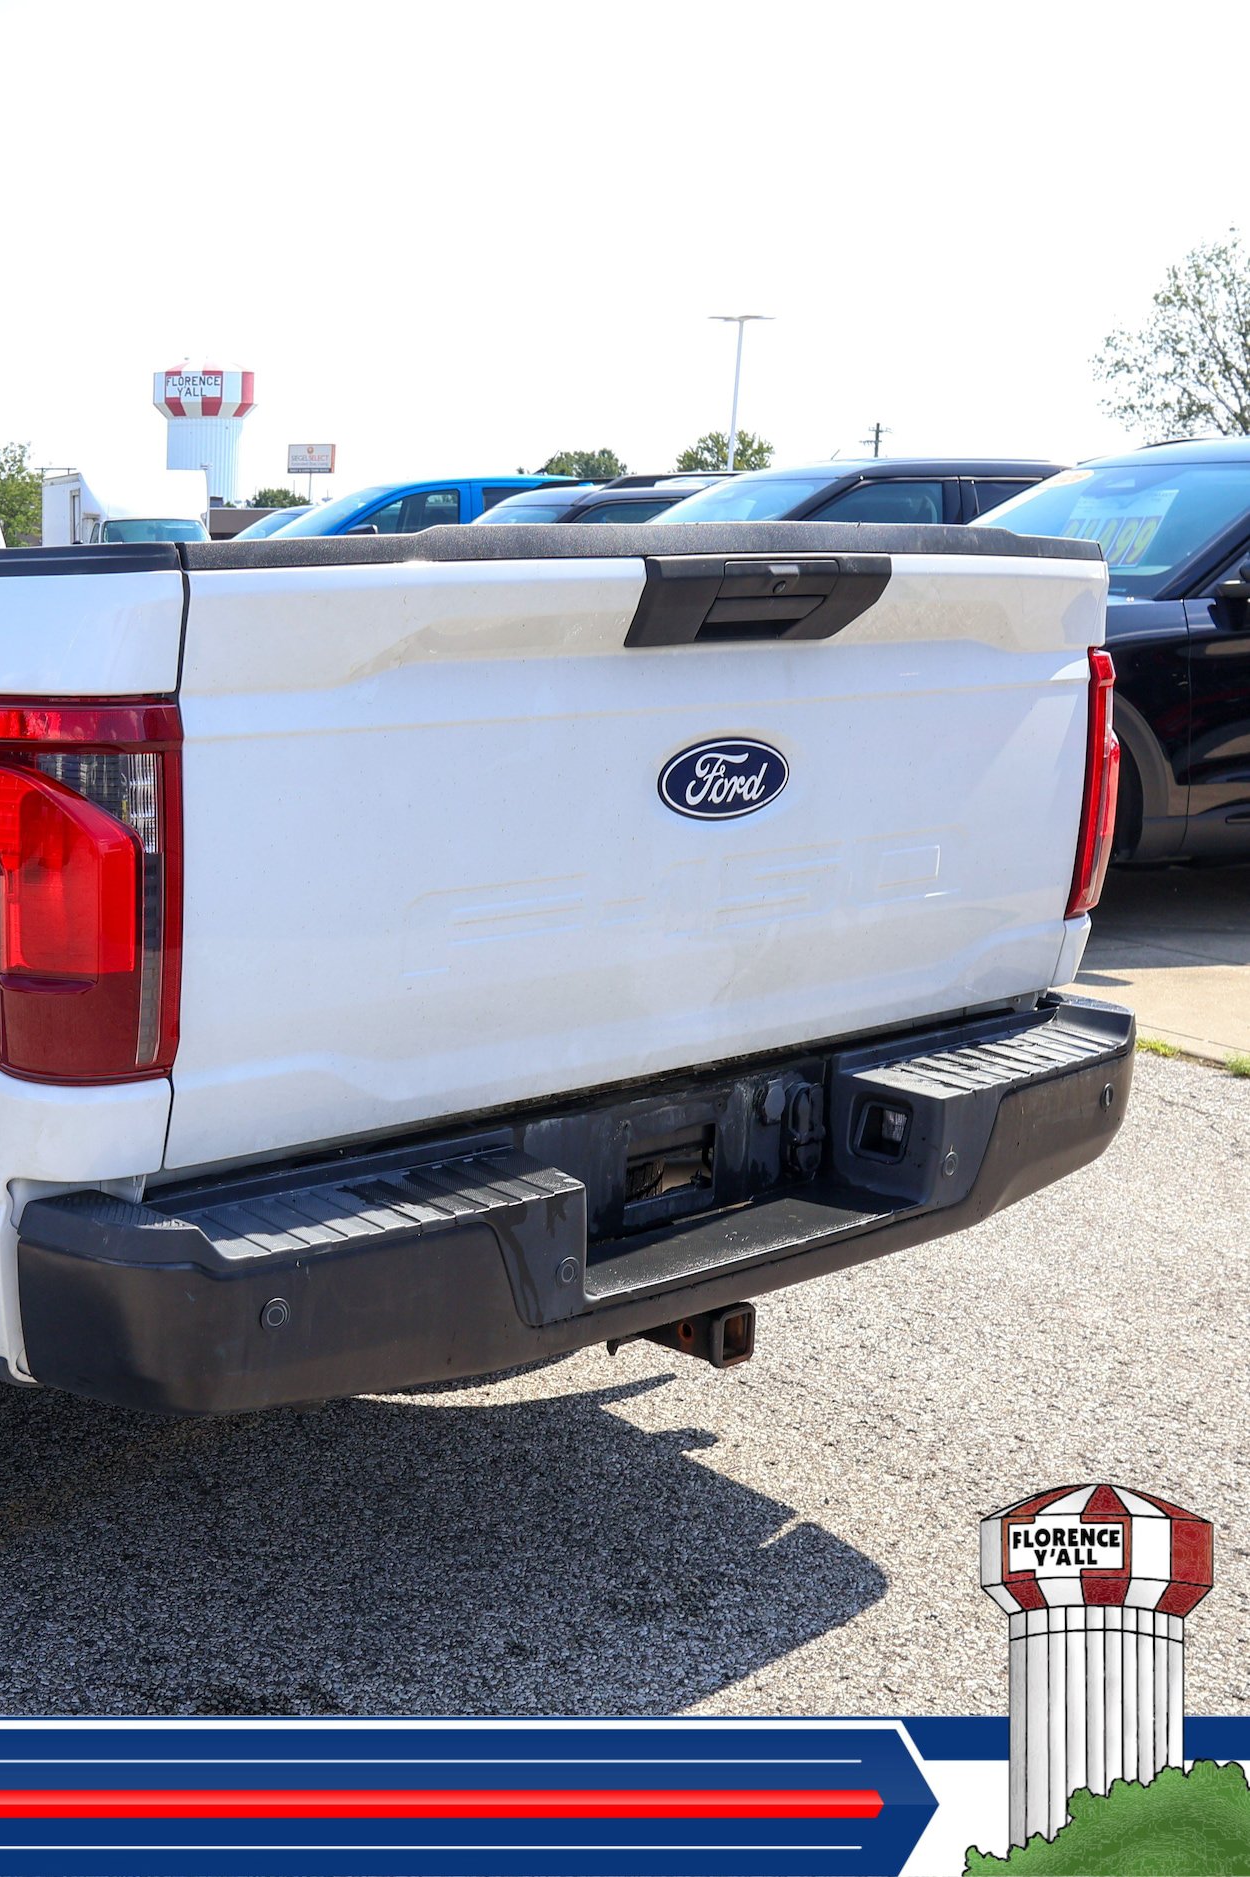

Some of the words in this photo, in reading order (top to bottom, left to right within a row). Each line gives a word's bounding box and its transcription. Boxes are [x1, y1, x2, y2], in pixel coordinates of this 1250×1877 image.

[166, 376, 221, 387] FLORENCE
[177, 387, 207, 397] Y'ALL
[685, 752, 769, 806] Ford
